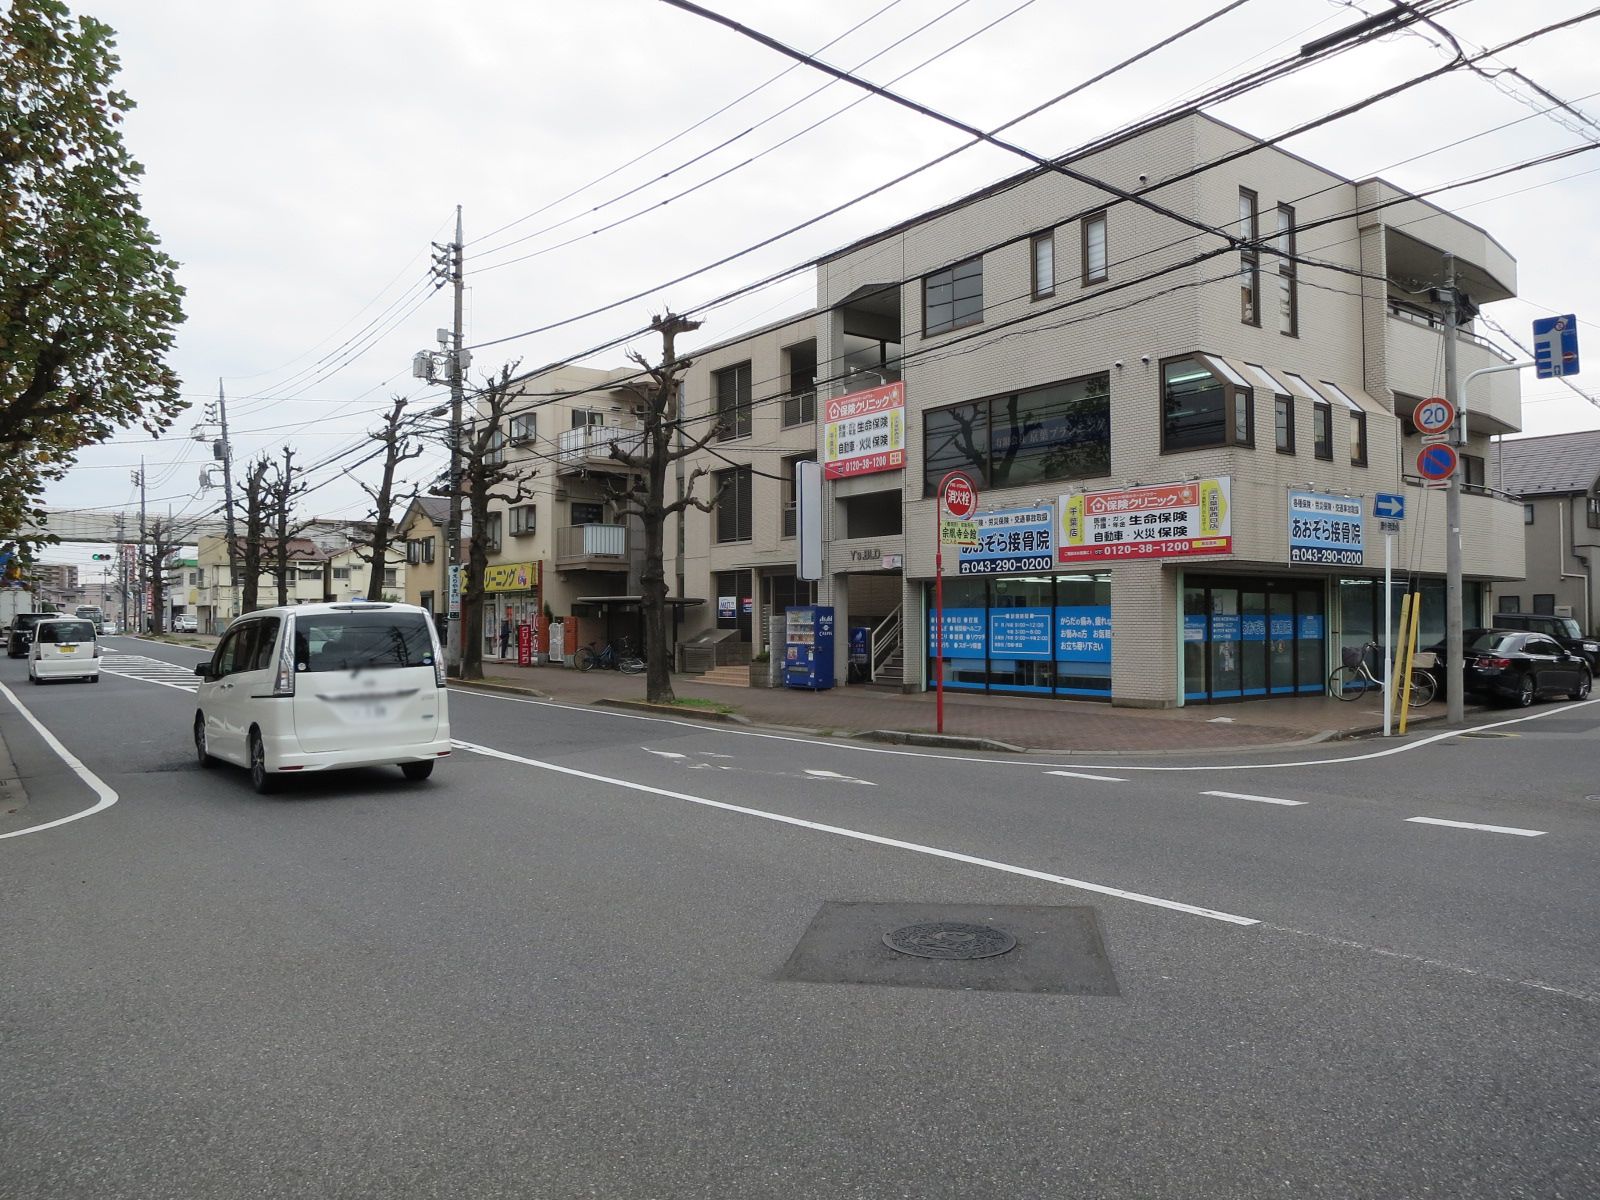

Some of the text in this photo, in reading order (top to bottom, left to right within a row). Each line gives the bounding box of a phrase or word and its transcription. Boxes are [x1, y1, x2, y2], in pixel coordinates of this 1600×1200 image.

[840, 396, 889, 417] 保険クリニック
[1423, 408, 1445, 424] 20
[857, 416, 888, 433] 生命保険
[839, 434, 888, 454] 自動車・火災保険
[846, 456, 886, 472] 0120-38-1200
[948, 490, 970, 506] 消火栓
[1107, 494, 1177, 512] 保険クリニック
[1070, 507, 1078, 537] 千葉店
[1129, 511, 1188, 526] 生命保険
[1094, 526, 1188, 543] 自動車・火災保険
[1292, 517, 1361, 544] あおぞら接骨院
[1104, 541, 1189, 555] 0120-38-1200
[971, 557, 1051, 571] 043-290-0200
[1301, 549, 1362, 564] 043-290-0200
